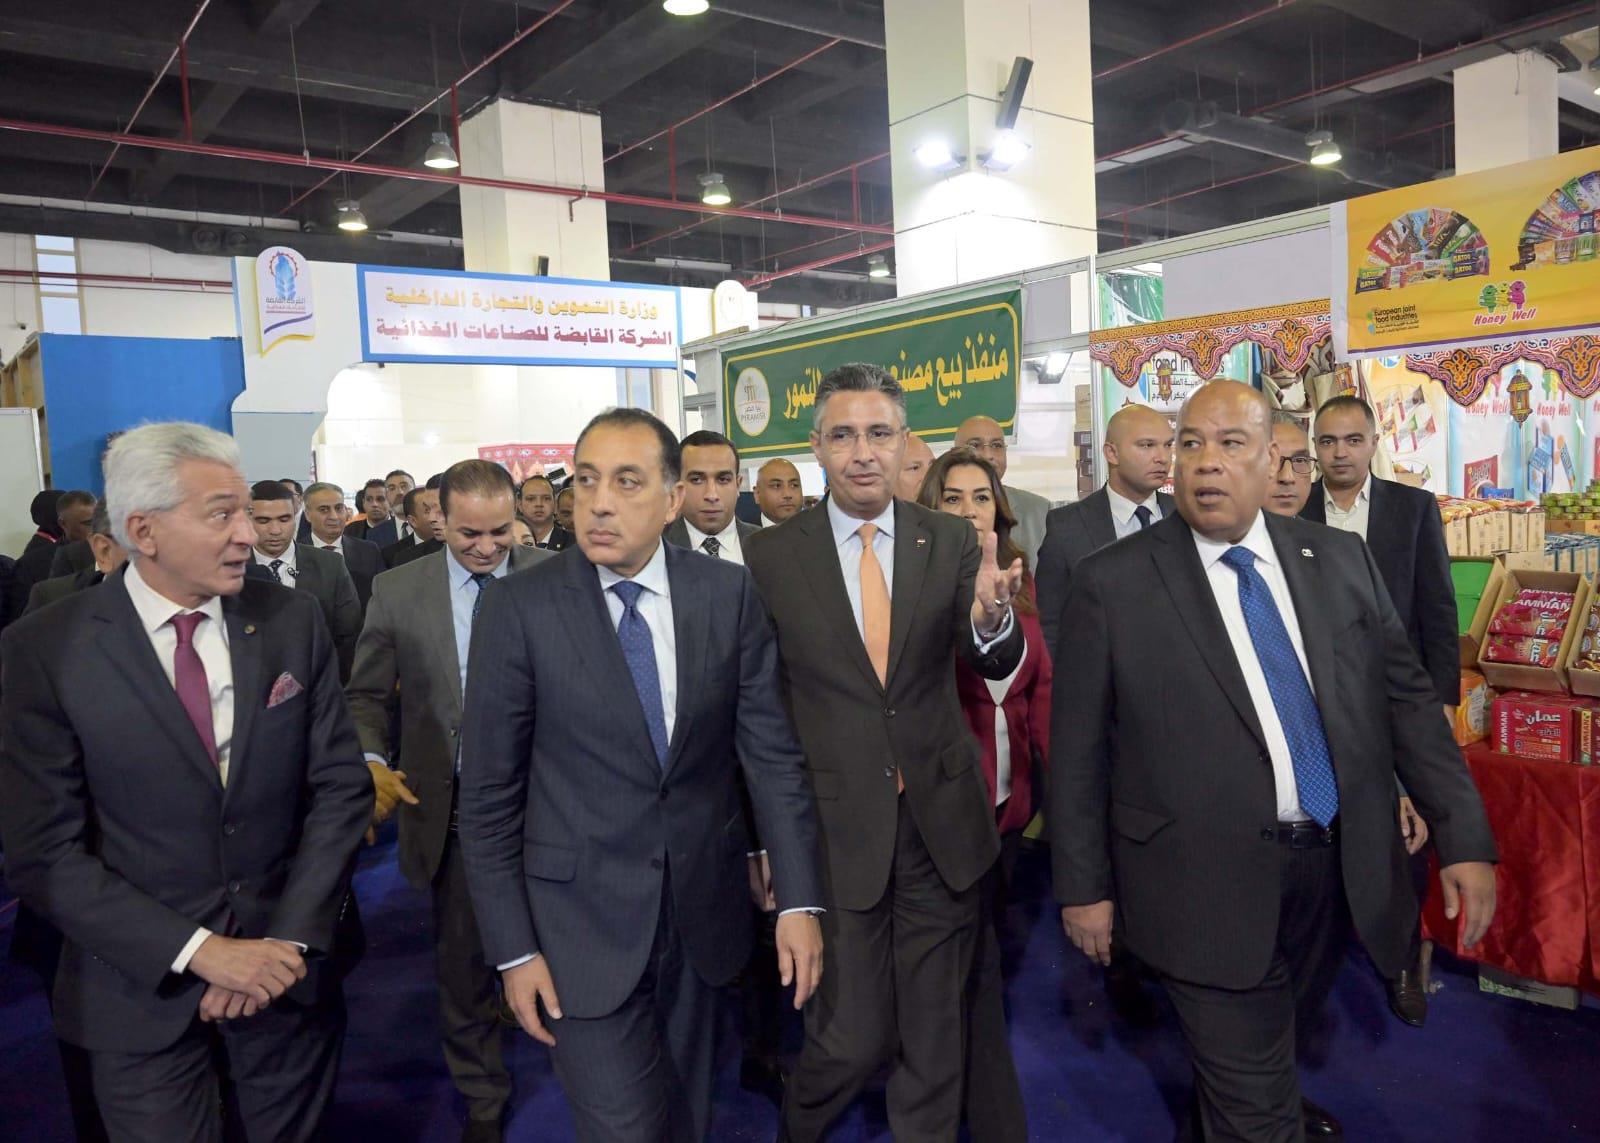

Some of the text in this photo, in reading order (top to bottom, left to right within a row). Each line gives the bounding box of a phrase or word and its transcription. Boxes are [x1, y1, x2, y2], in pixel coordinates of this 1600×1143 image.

[385, 286, 659, 320] وزارة التموين والتجارة الداخلية
[1374, 306, 1402, 317] European
[1390, 312, 1418, 321] industries
[1474, 307, 1536, 326] Honey Well
[376, 318, 672, 348] الشركة القابضة للصناعات الغذائية
[965, 332, 1009, 384] منفذ
[935, 351, 963, 407] بيع
[1536, 402, 1571, 418] Honey Well
[1500, 711, 1509, 744] AMMAN
[1526, 709, 1561, 726] عمان
